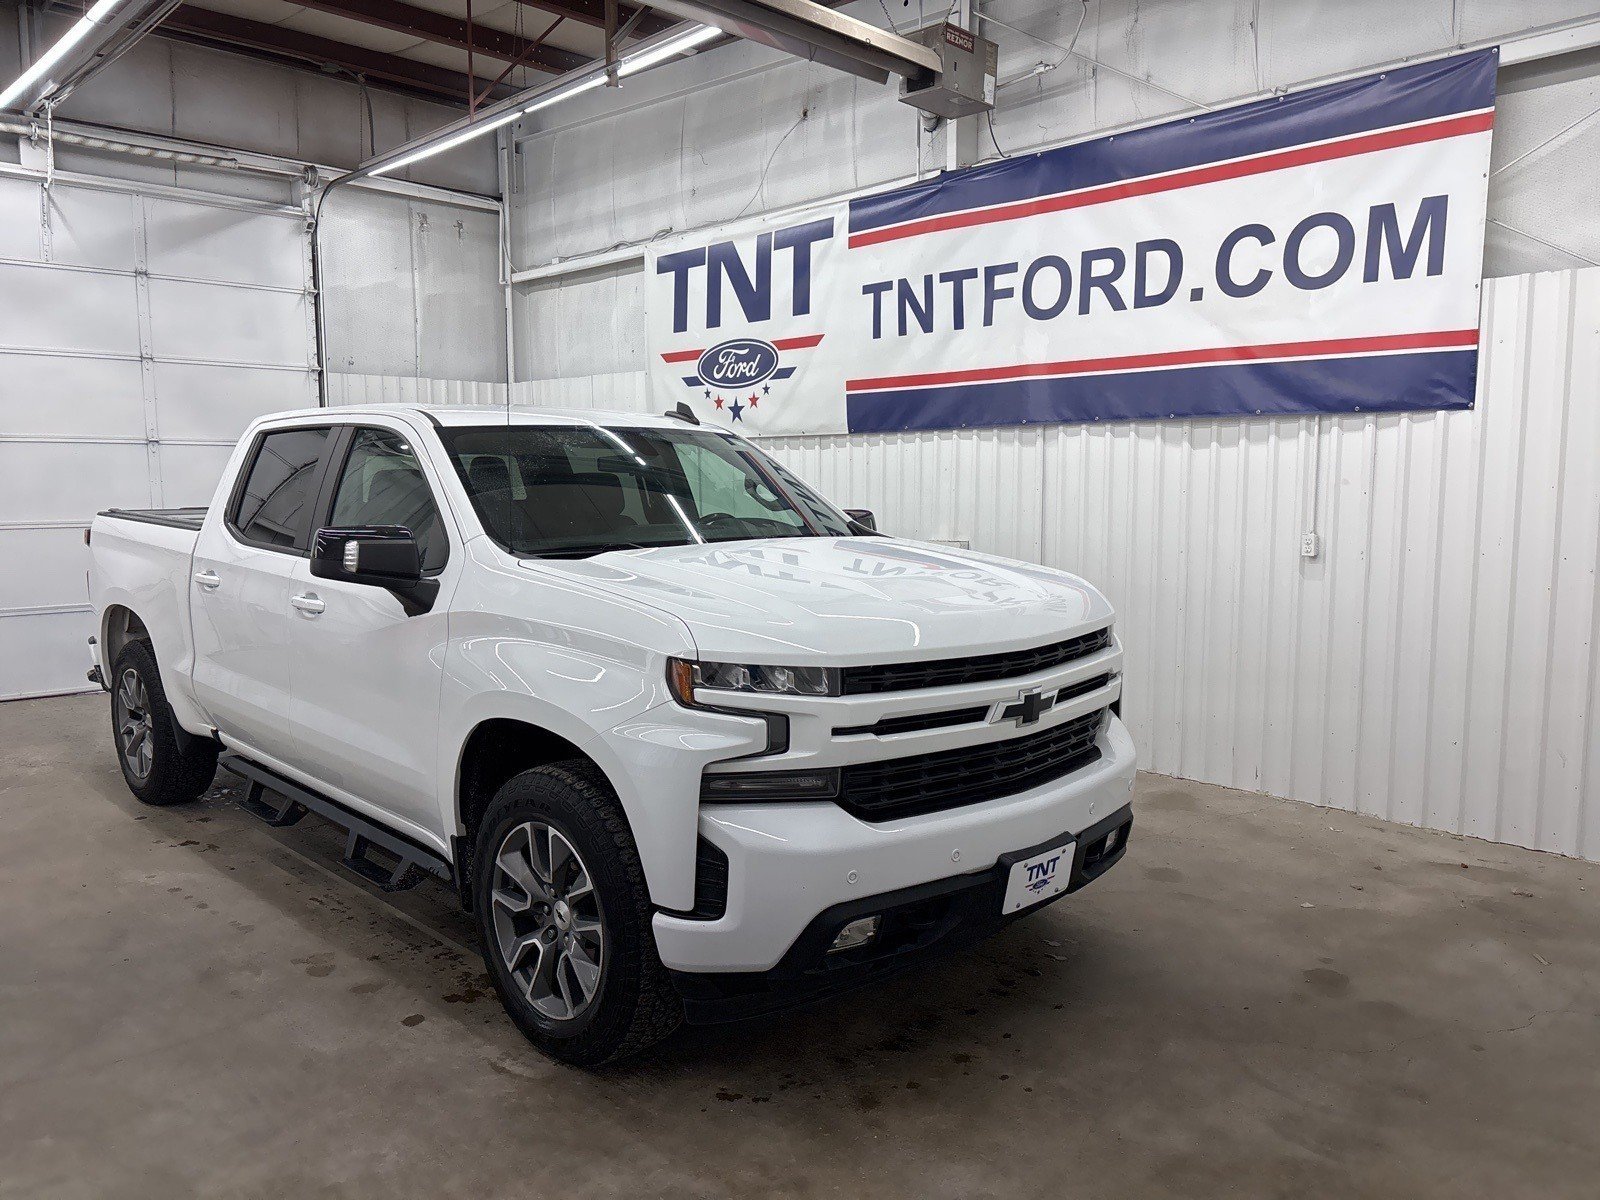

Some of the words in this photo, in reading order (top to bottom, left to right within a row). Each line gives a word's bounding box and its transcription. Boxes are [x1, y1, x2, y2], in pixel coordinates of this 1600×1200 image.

[946, 31, 973, 50] REZNOR
[656, 216, 835, 333] TNT
[862, 194, 1449, 339] TNTFORD.COM
[713, 347, 761, 379] Ford
[1026, 856, 1060, 882] TNT
